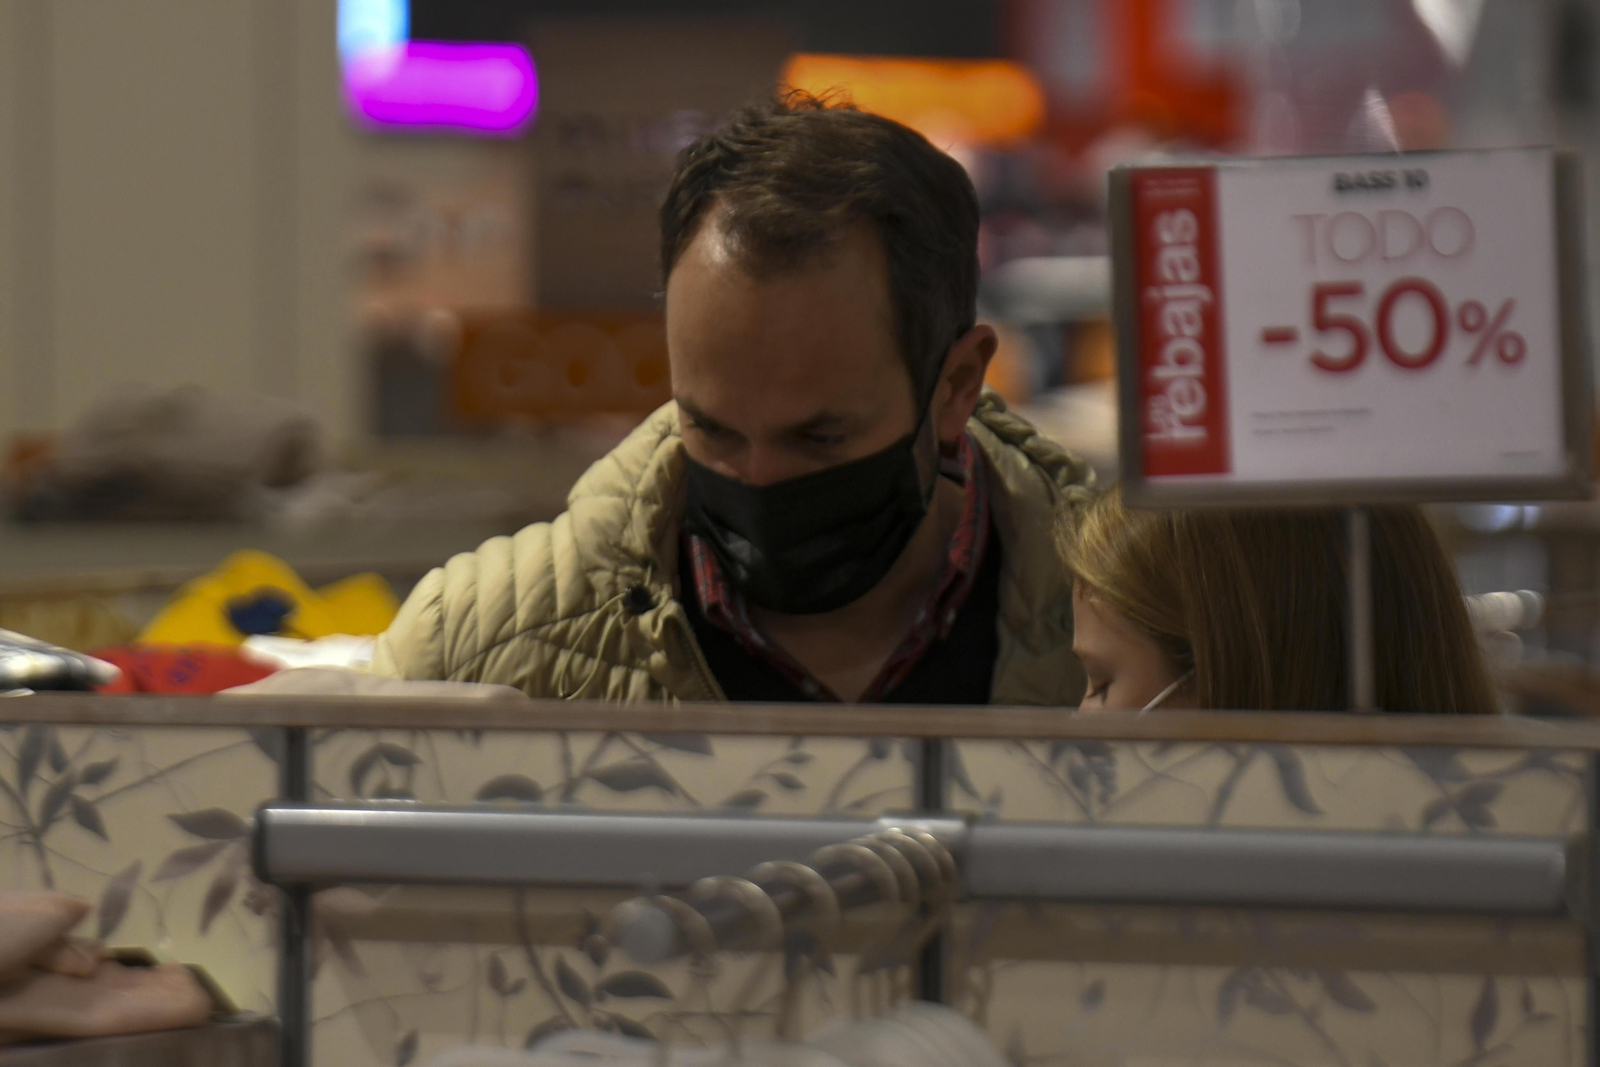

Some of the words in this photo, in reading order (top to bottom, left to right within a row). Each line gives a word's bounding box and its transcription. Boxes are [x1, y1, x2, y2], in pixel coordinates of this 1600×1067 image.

[1291, 206, 1476, 265] TODO
[1148, 207, 1212, 442] rebajas
[1261, 277, 1526, 375] -50%
